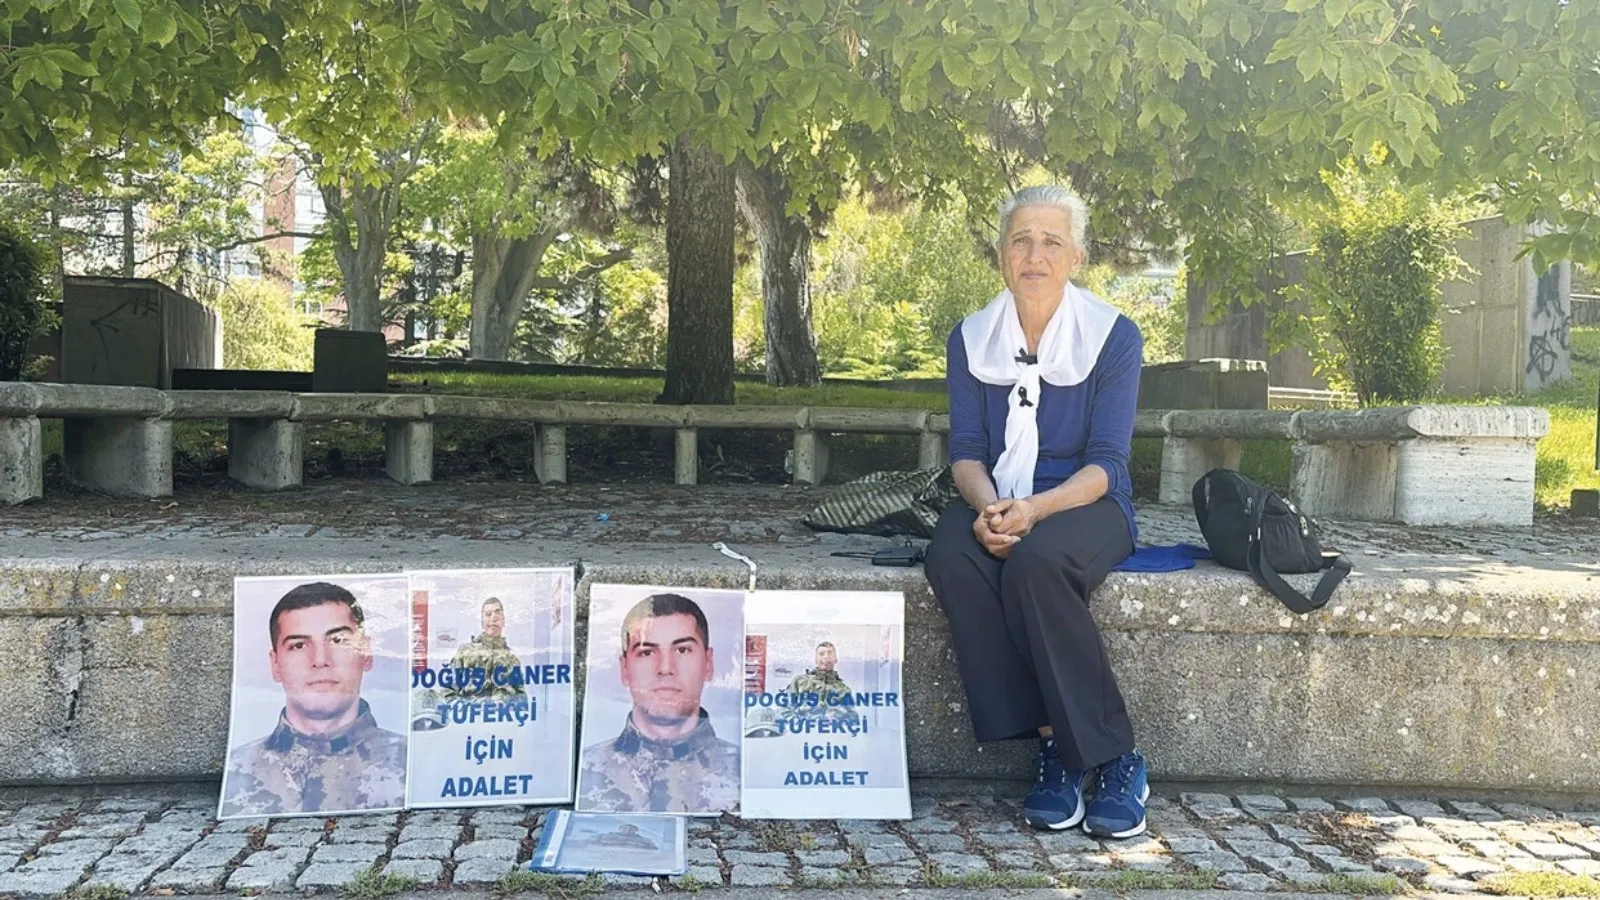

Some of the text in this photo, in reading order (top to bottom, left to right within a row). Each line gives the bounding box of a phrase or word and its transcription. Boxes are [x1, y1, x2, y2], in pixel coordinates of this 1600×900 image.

[494, 664, 571, 685] CANER
[826, 691, 899, 707] CANER
[465, 735, 513, 764] İÇİN
[803, 742, 848, 763] İÇİN
[441, 774, 533, 797] ADALET
[784, 771, 869, 786] ADALET
